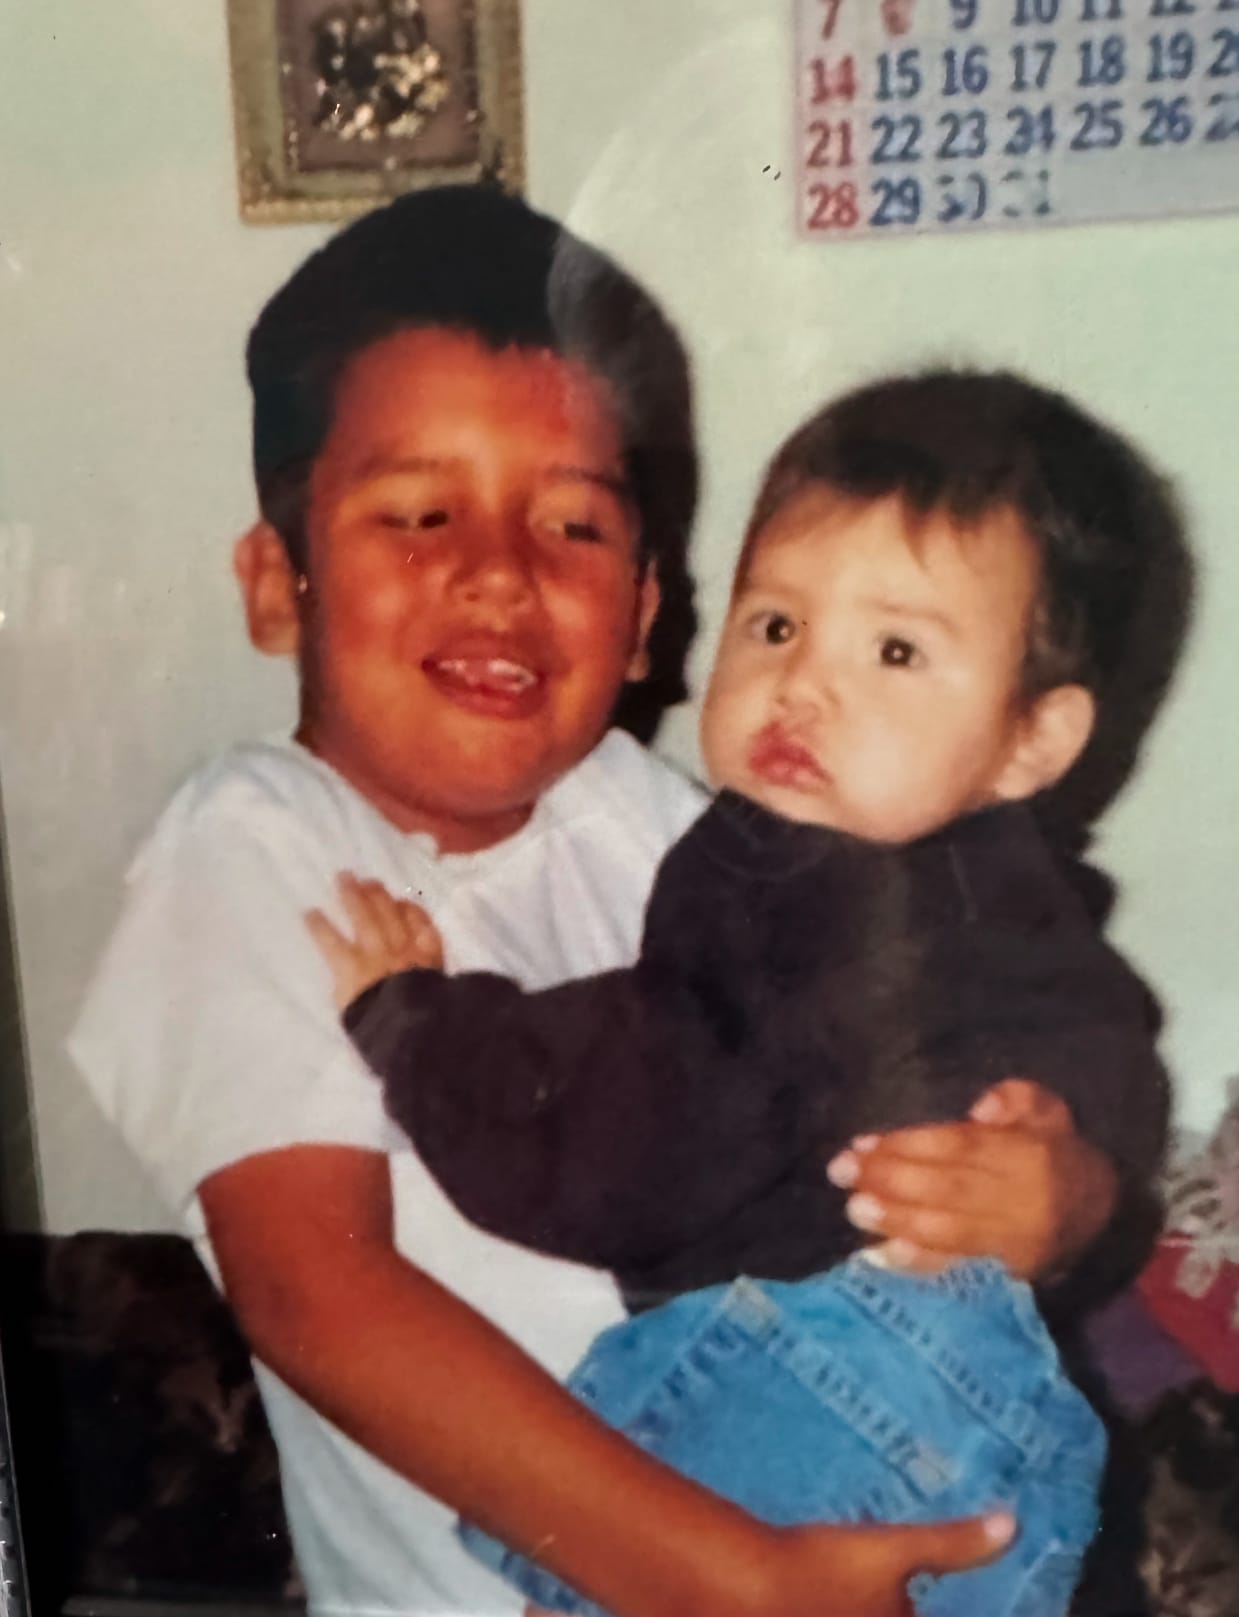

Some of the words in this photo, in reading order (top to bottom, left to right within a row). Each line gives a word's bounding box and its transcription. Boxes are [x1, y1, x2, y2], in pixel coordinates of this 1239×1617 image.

[811, 55, 857, 105] 14
[875, 49, 922, 101] 15
[942, 45, 989, 96] 16
[1010, 40, 1056, 92] 17
[1077, 34, 1125, 87] 18
[1147, 31, 1195, 83] 19
[1207, 28, 1239, 77] 2
[807, 119, 853, 168] 21
[870, 115, 922, 165] 22
[936, 111, 987, 160] 23
[1070, 100, 1123, 150] 25
[1140, 96, 1193, 146] 26
[807, 182, 860, 230] 28
[870, 177, 921, 226] 29
